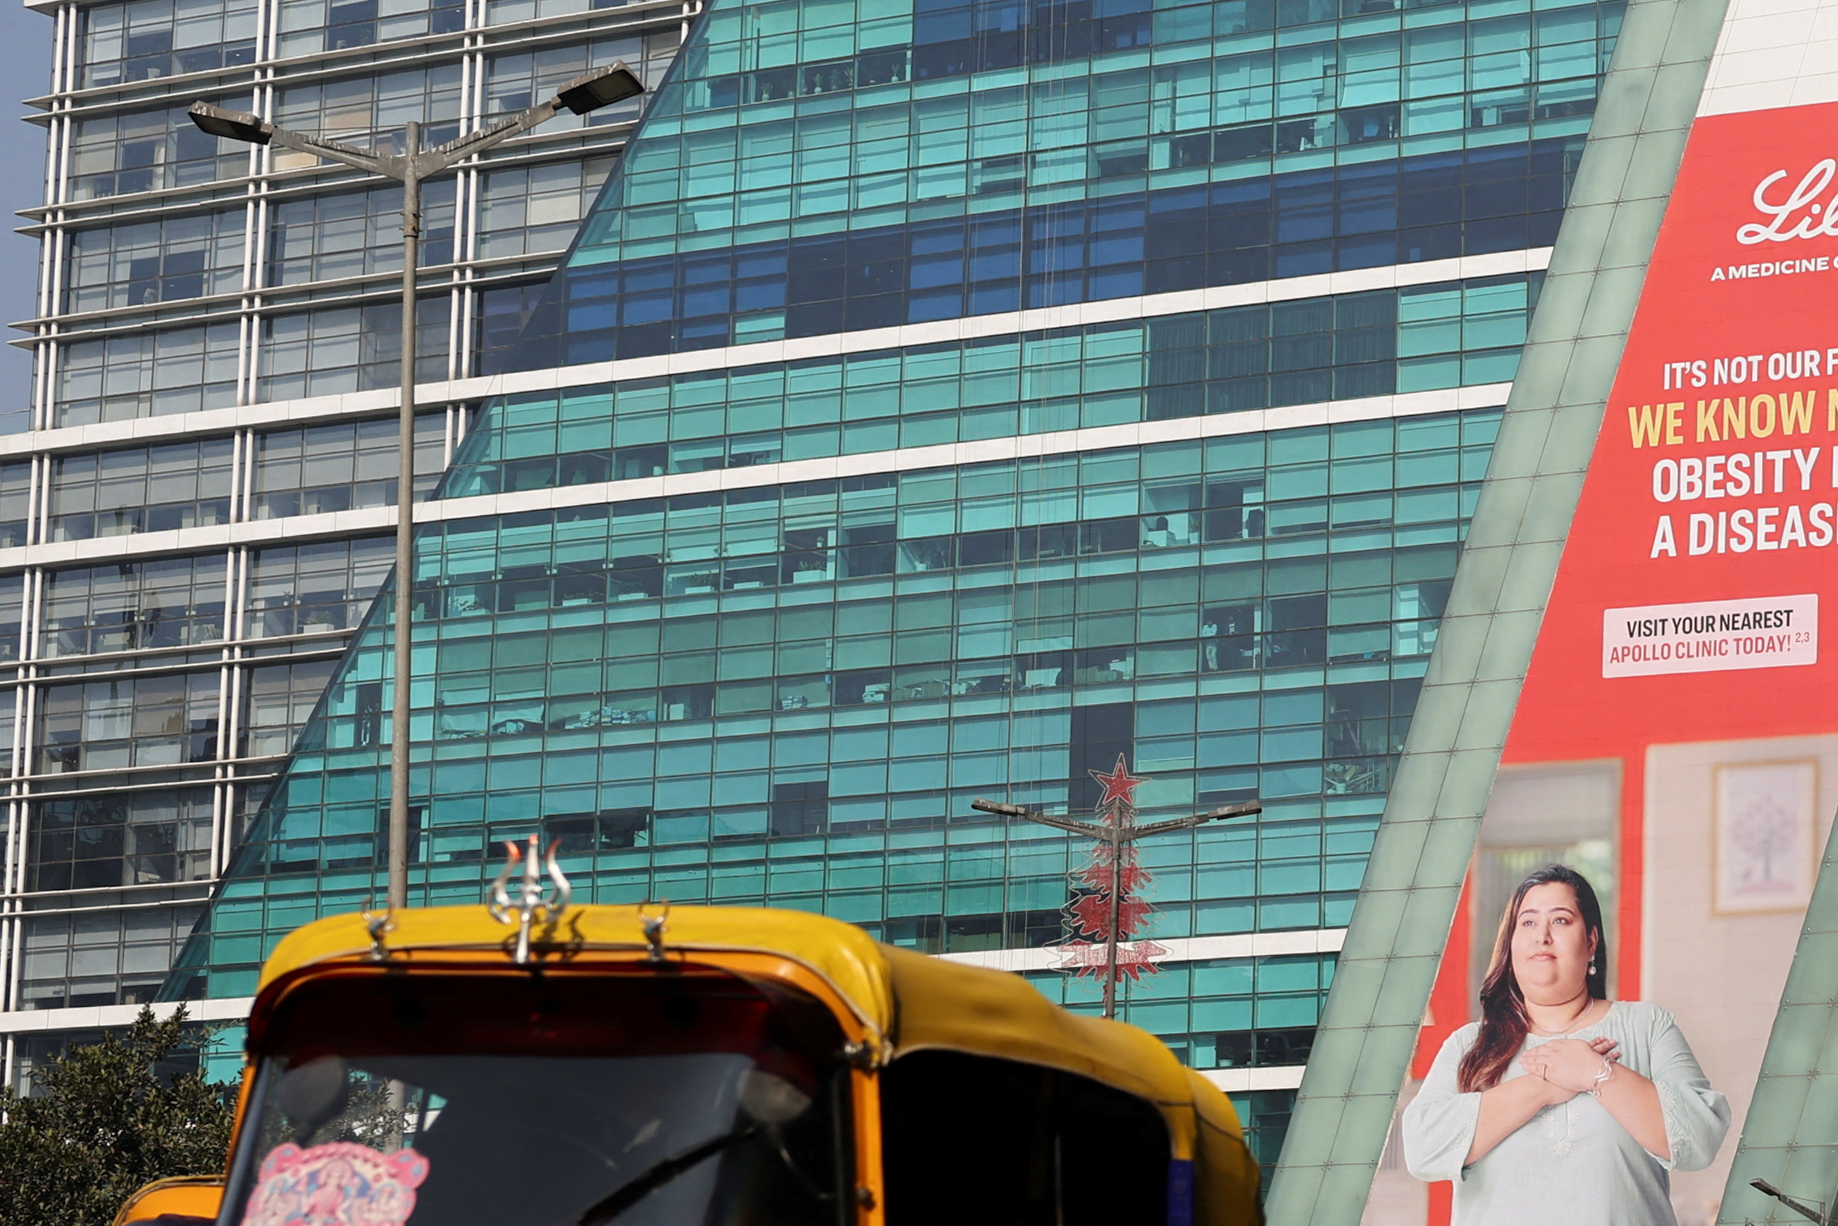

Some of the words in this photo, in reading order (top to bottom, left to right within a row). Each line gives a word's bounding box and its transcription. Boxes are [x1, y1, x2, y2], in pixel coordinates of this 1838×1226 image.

[1710, 267, 1726, 281] A
[1728, 256, 1830, 280] MEDICINE
[1713, 355, 1763, 386] NOT
[1767, 350, 1820, 381] OUR
[1628, 402, 1685, 449] WE
[1696, 390, 1816, 443] KNOW
[1652, 446, 1821, 503] OBESITY
[1650, 515, 1678, 559] A
[1626, 618, 1668, 638] VISIT
[1672, 615, 1716, 635] YOUR
[1719, 609, 1794, 632] NEAREST
[1609, 642, 1671, 664] APOLLO
[1675, 638, 1729, 659] CLINIC
[1733, 634, 1791, 655] TODAY!
